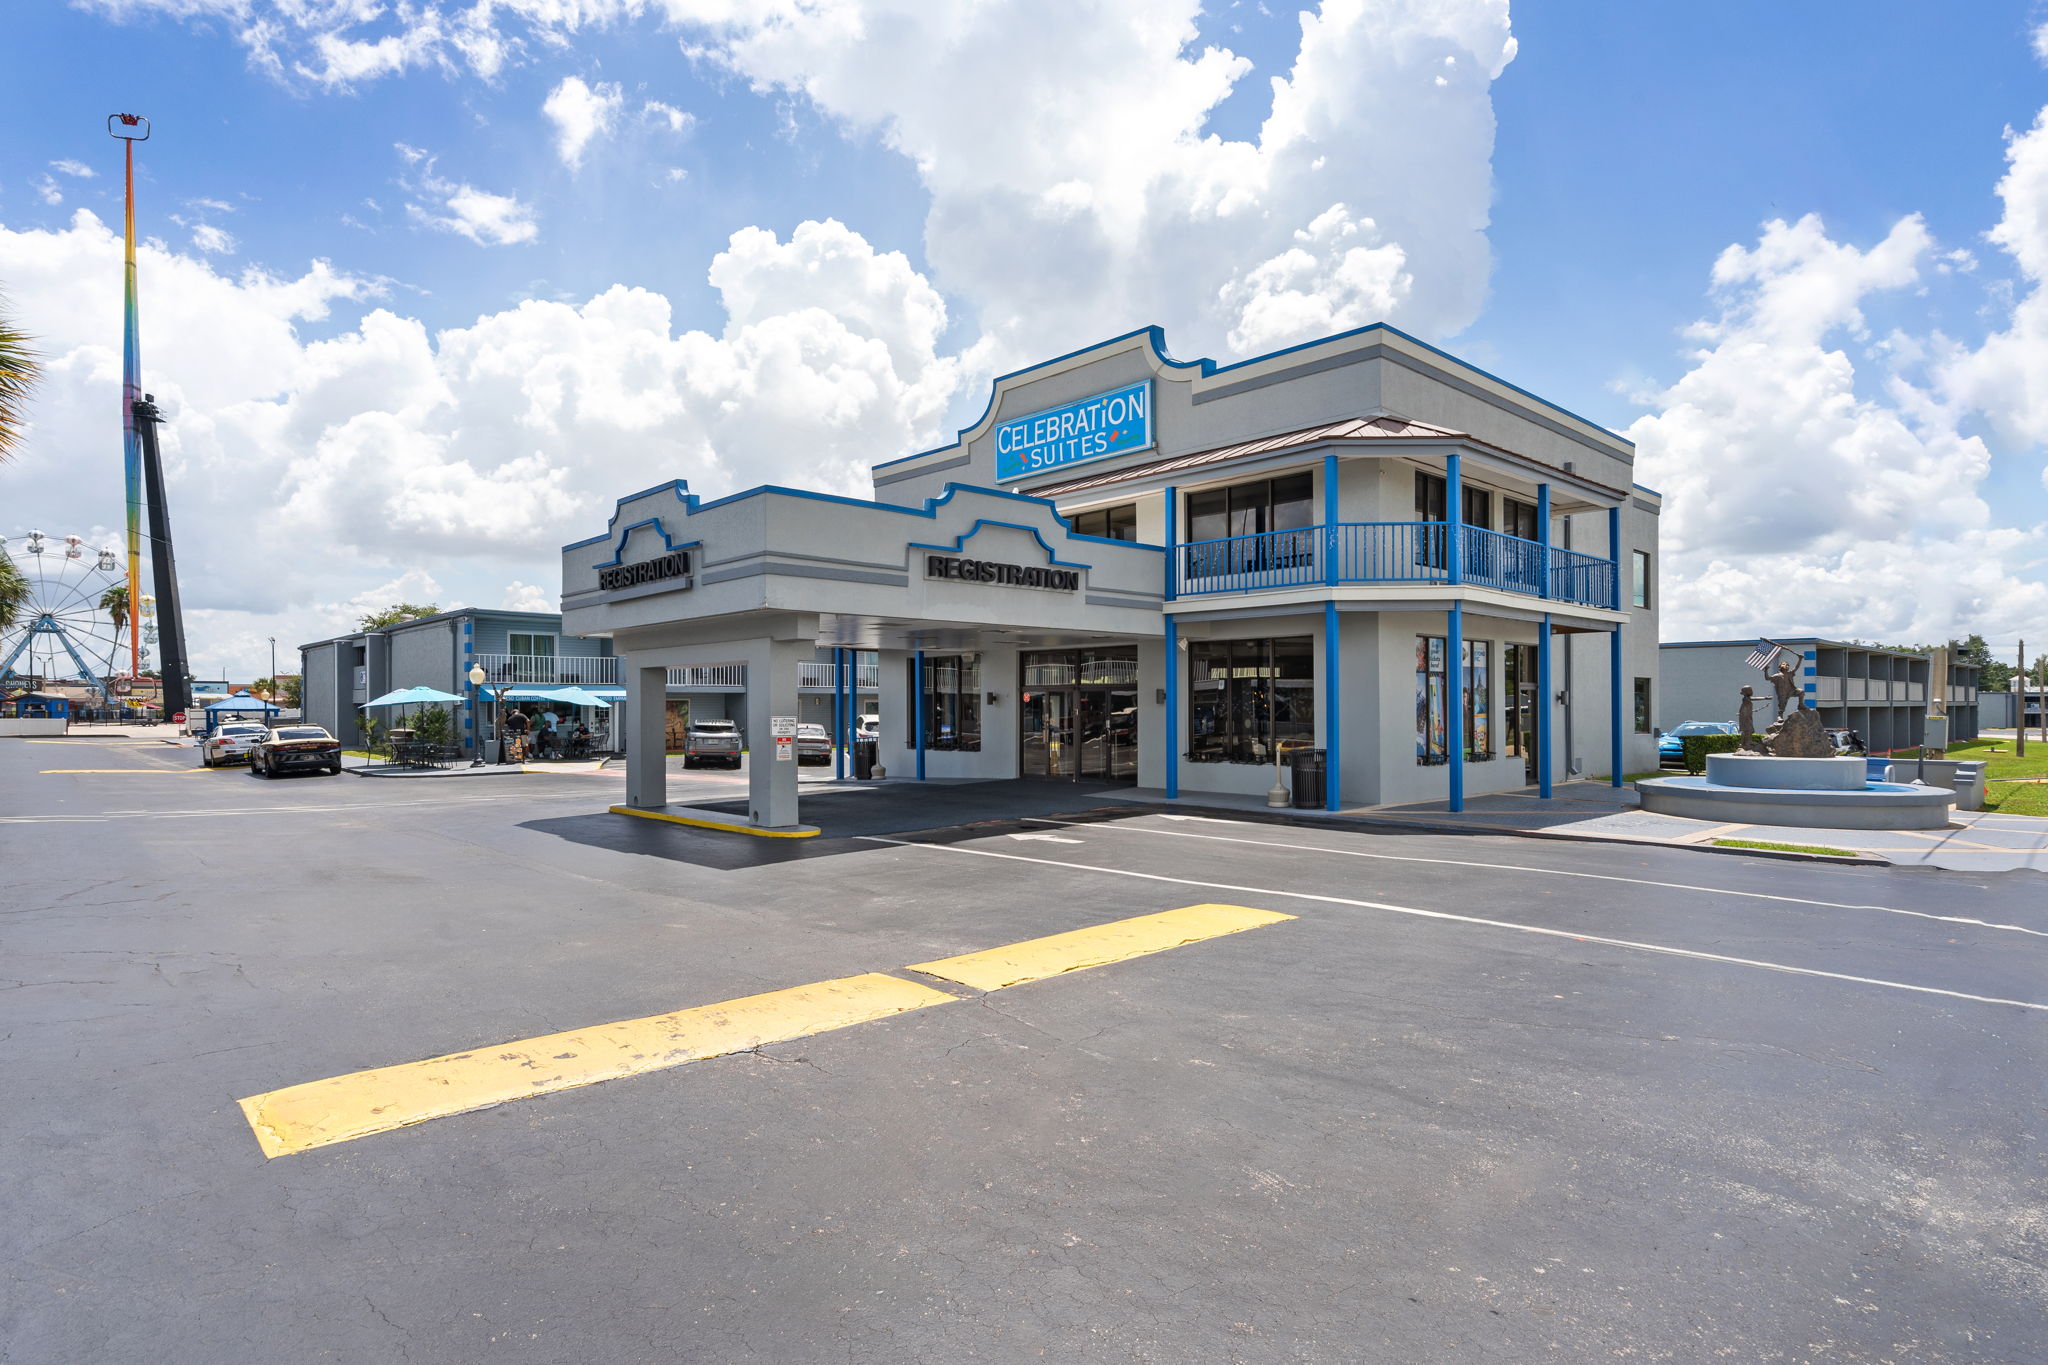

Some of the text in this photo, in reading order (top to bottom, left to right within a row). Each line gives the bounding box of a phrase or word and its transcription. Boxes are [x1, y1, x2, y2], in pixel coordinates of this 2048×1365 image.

[1031, 432, 1107, 468] SUITES
[599, 552, 689, 590] REGISTRATION
[928, 555, 1079, 591] REGISTRATION
